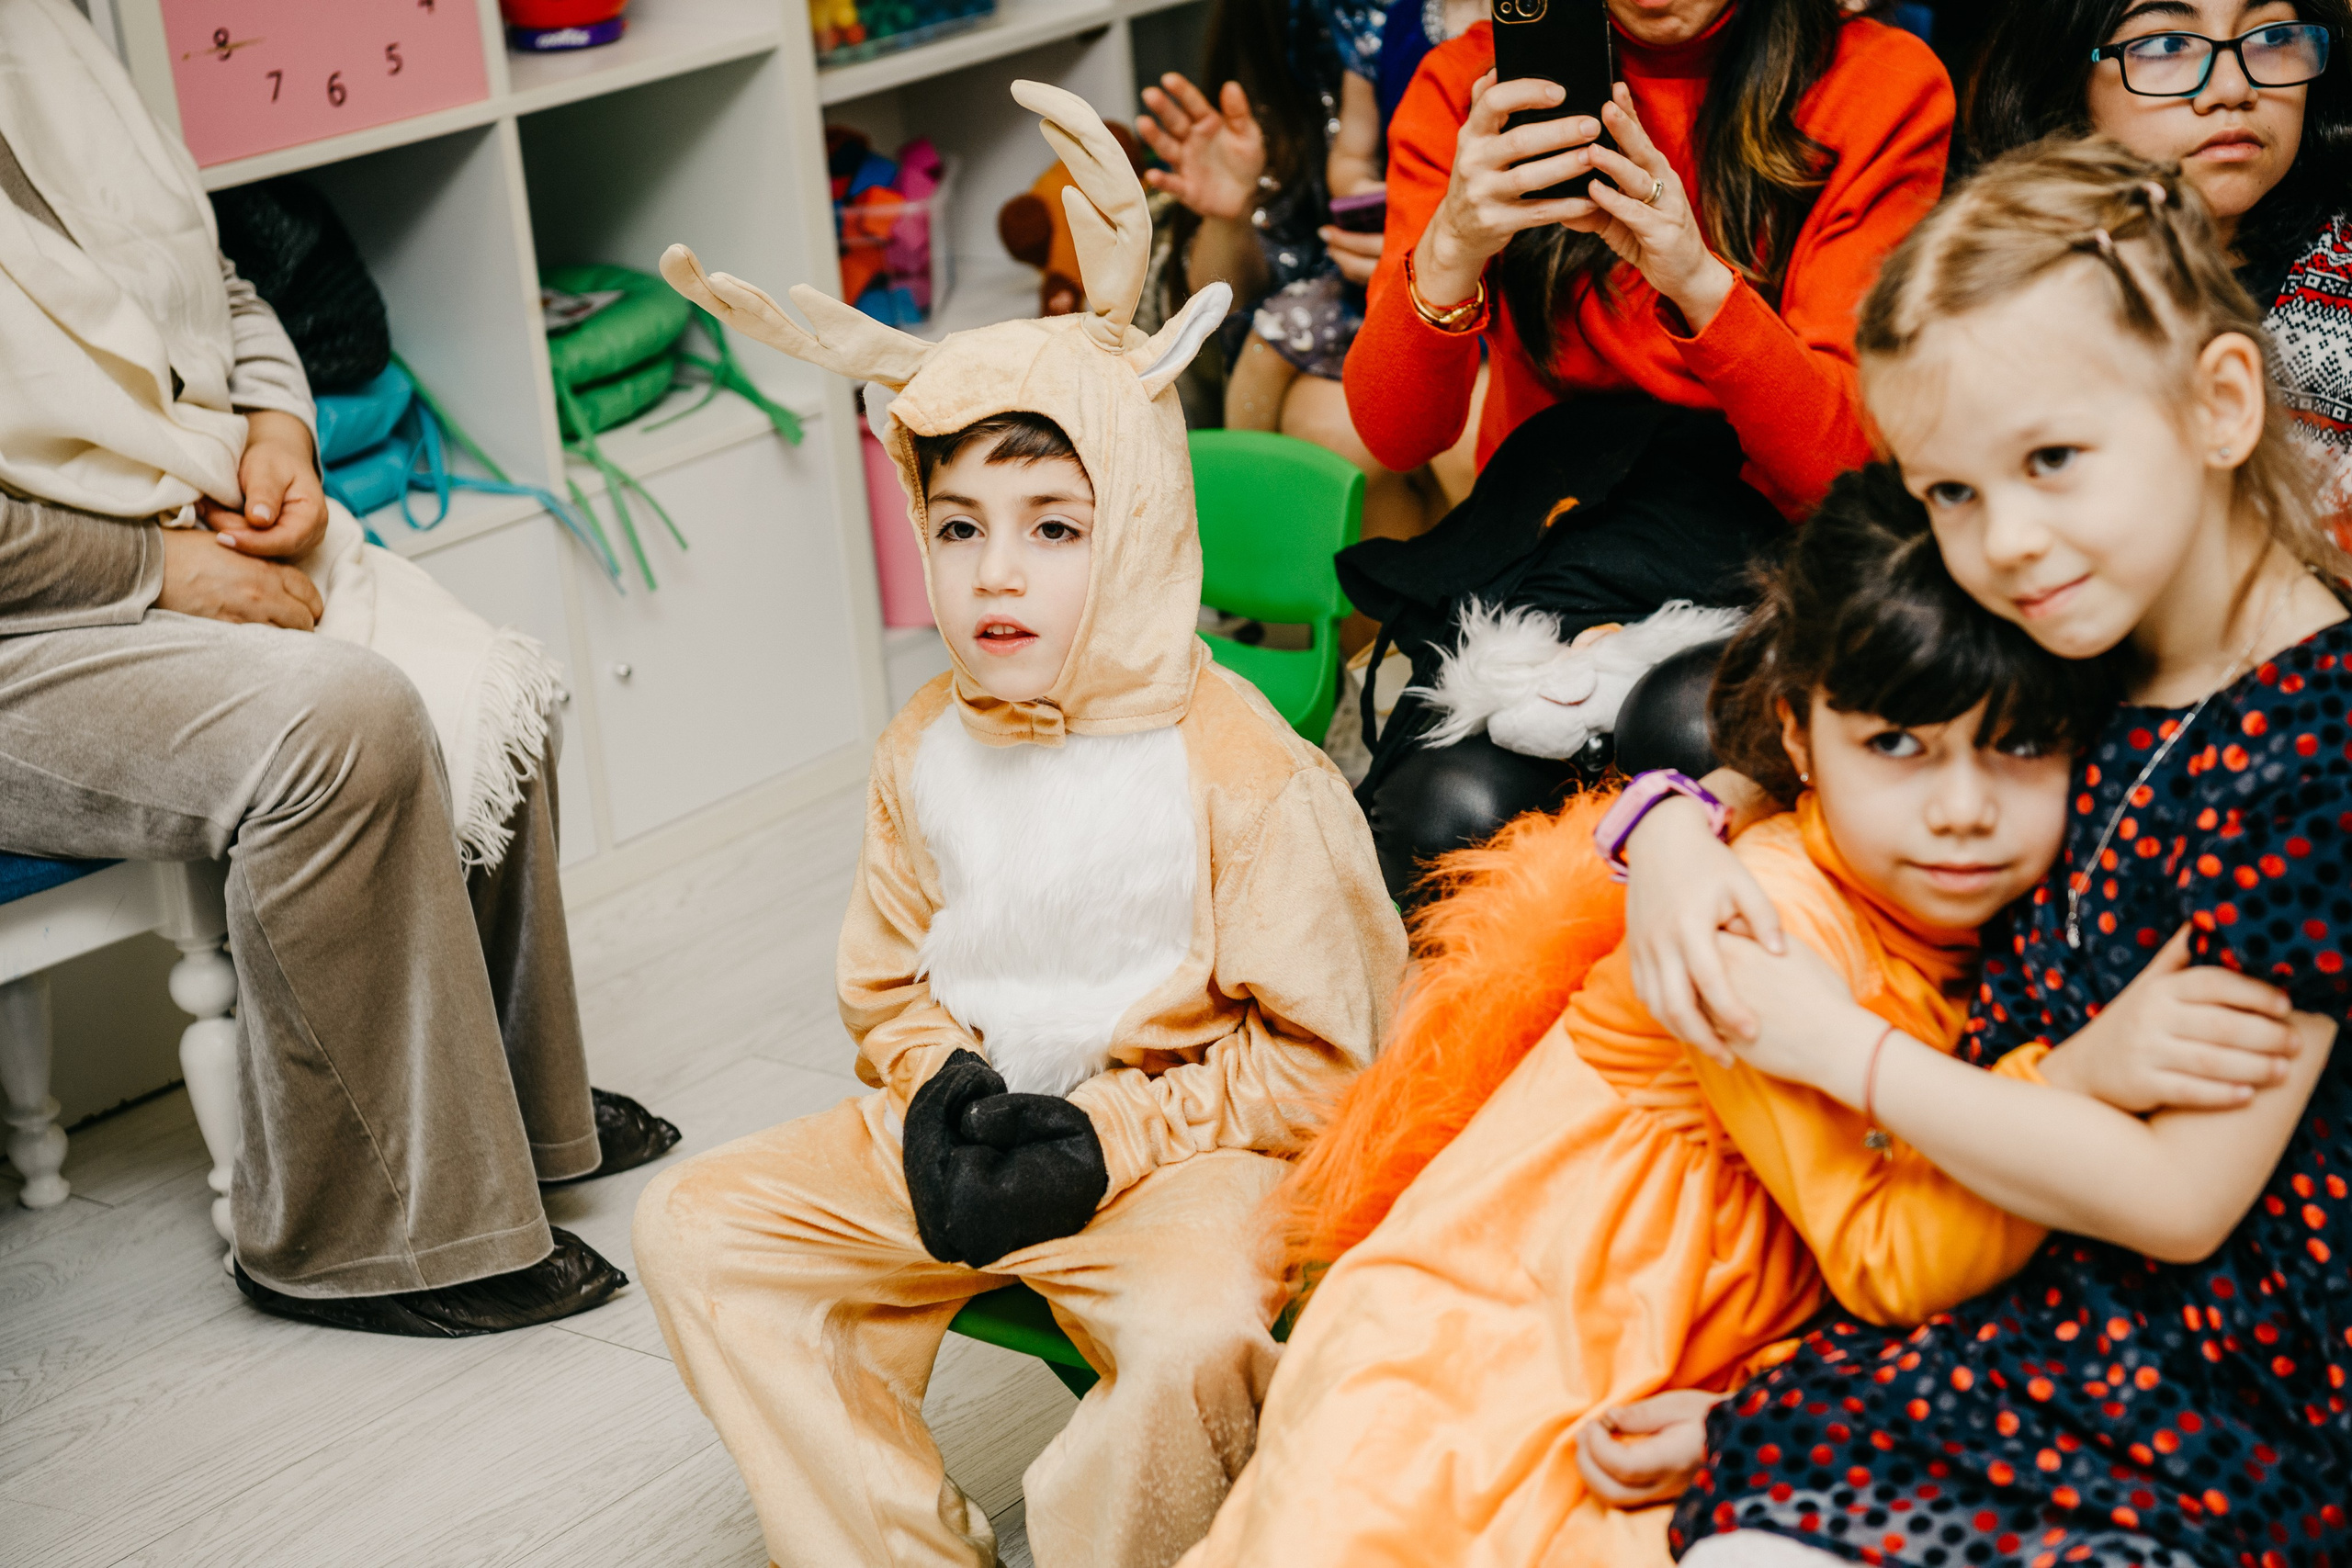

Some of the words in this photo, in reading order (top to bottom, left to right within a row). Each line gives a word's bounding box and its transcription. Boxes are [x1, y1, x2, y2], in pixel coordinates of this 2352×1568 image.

[385, 42, 402, 76] 5
[266, 69, 282, 103] 7
[326, 71, 346, 107] 6
